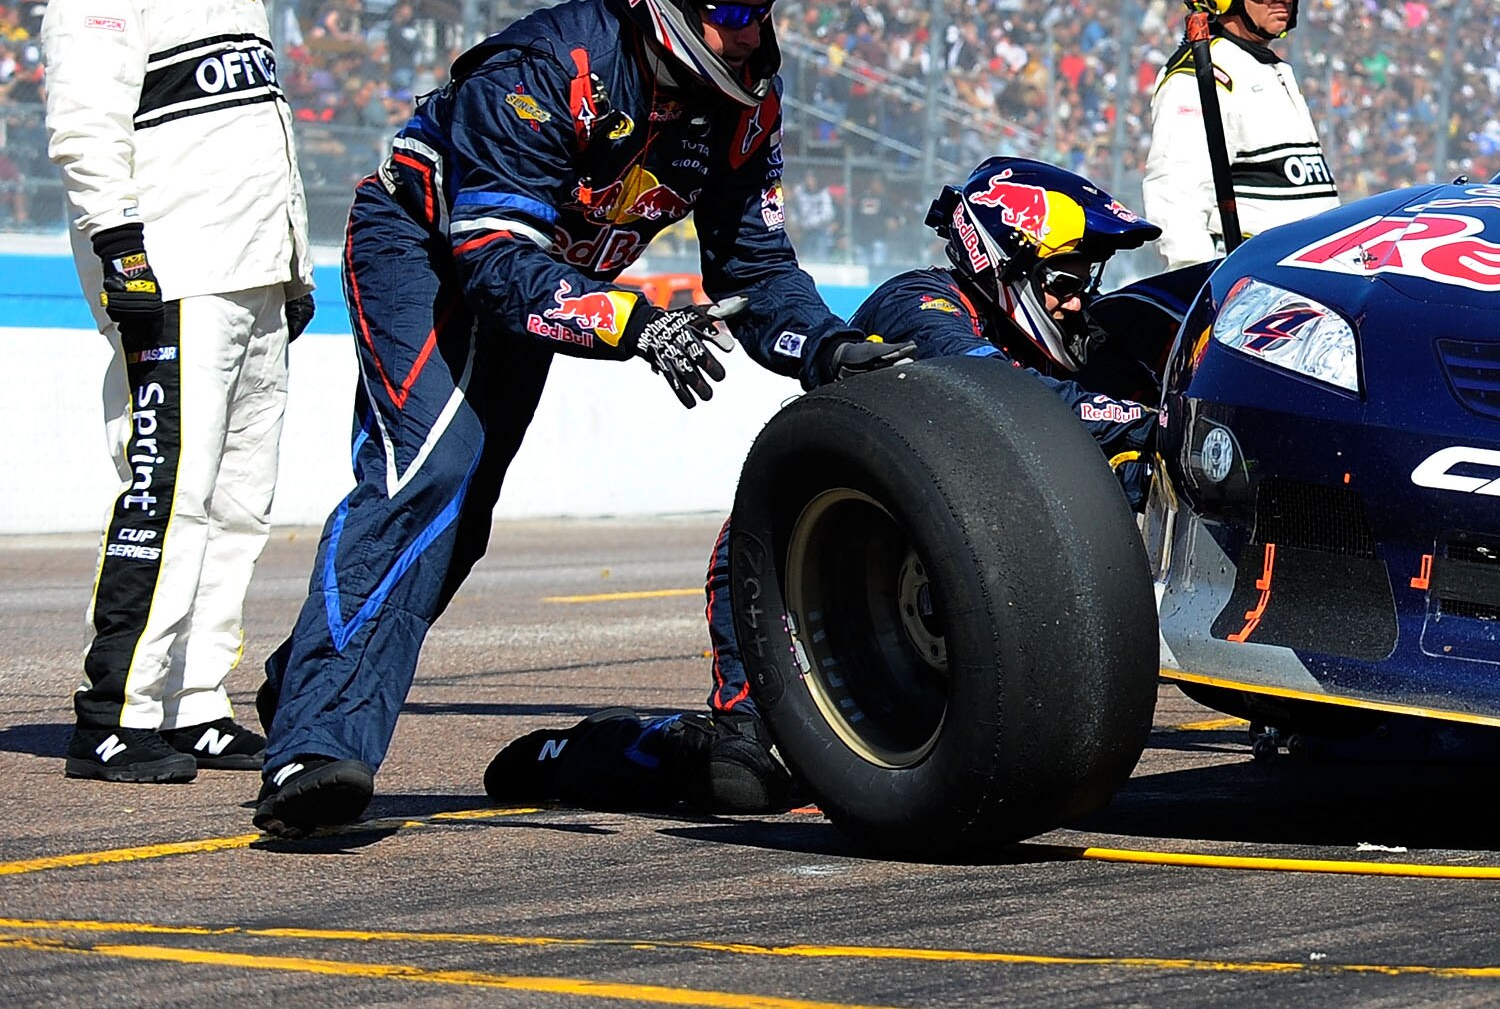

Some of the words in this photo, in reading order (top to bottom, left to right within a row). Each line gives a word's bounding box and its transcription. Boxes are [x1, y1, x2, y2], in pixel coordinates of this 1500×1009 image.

[527, 313, 562, 340] Red
[560, 323, 594, 349] Bull
[140, 346, 177, 362] NASCAR
[1081, 402, 1114, 422] Red
[1113, 404, 1142, 424] Bull
[123, 382, 165, 511] Sprint
[118, 528, 157, 543] CUP
[106, 543, 161, 560] SERIES
[95, 734, 128, 763] N
[194, 727, 234, 756] N
[538, 739, 568, 761] N
